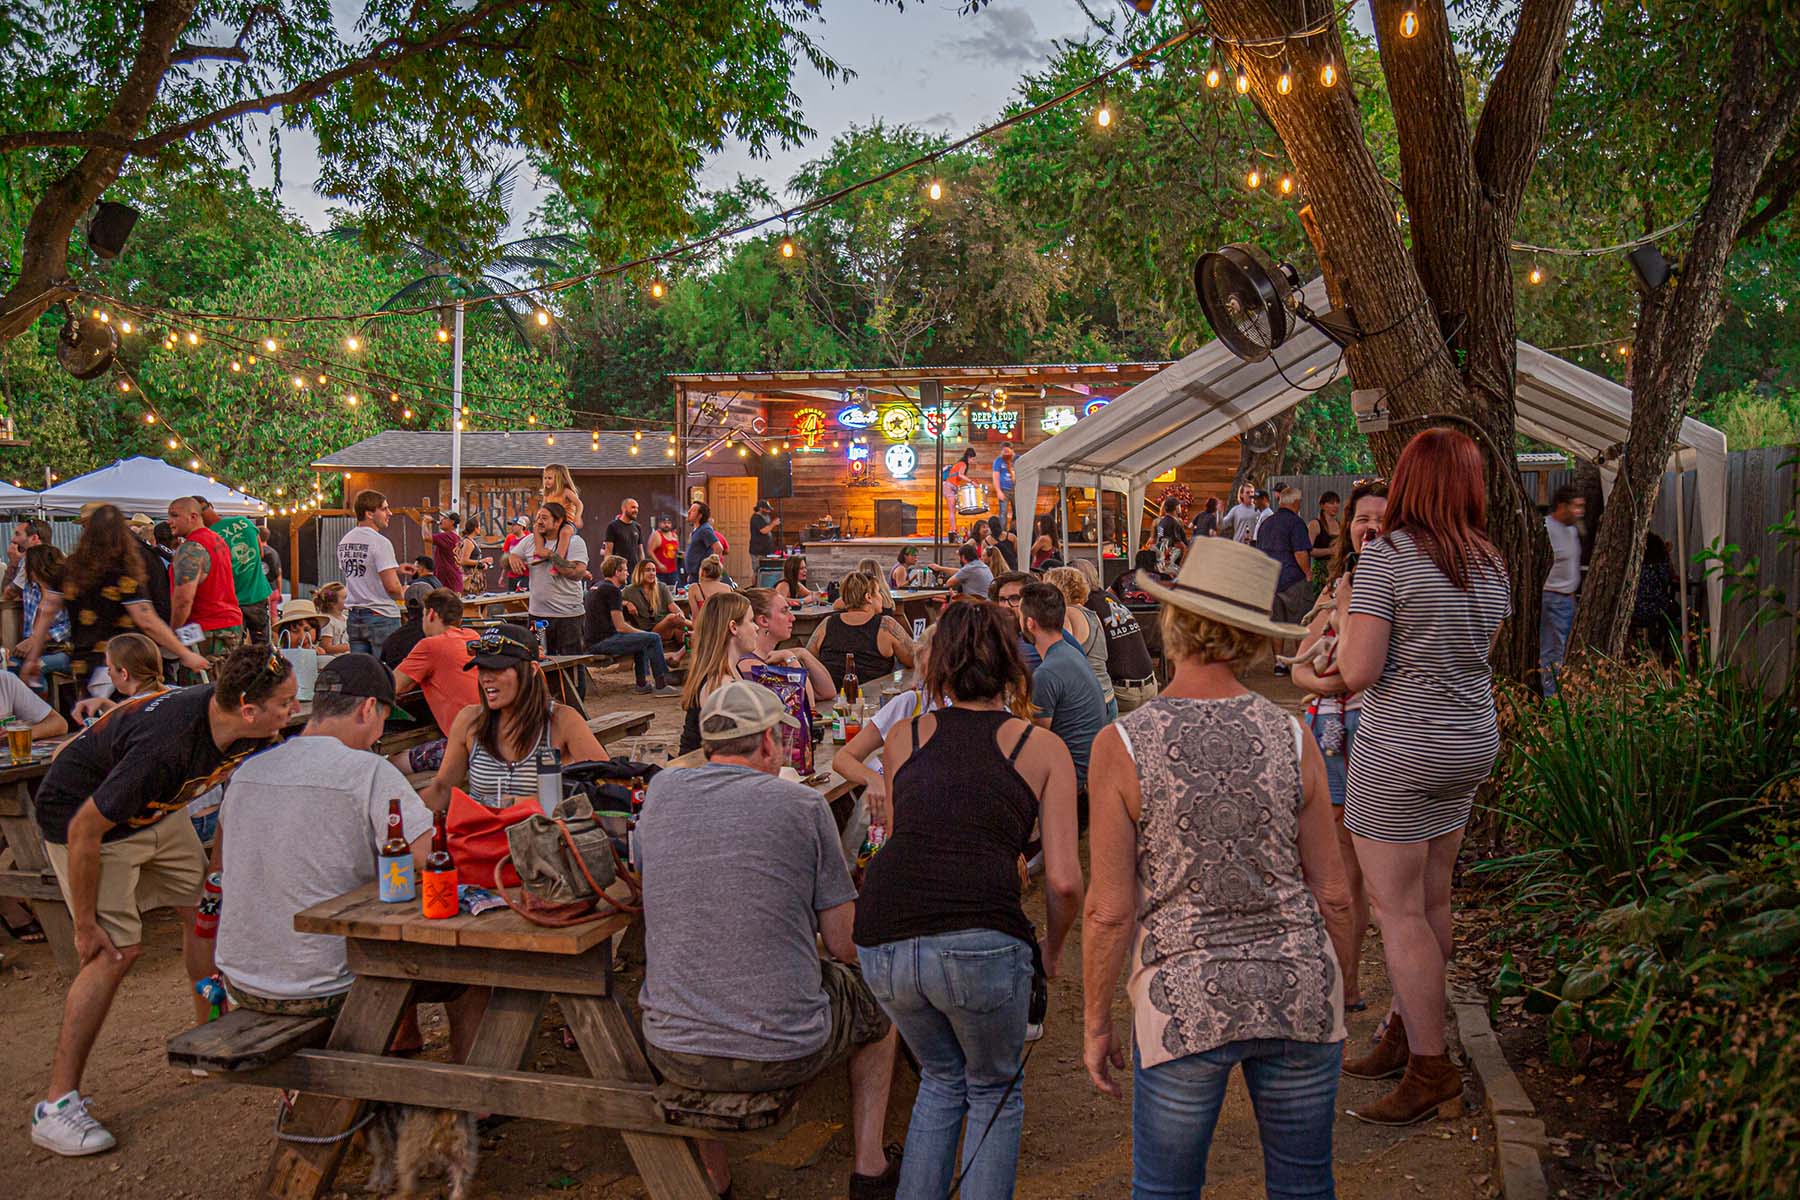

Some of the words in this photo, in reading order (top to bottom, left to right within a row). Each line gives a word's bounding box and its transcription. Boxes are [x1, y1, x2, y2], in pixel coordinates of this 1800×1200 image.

[971, 411, 992, 421] DEEP
[998, 411, 1018, 421] EDDY
[801, 413, 818, 447] 4
[1110, 626, 1128, 637] BAD
